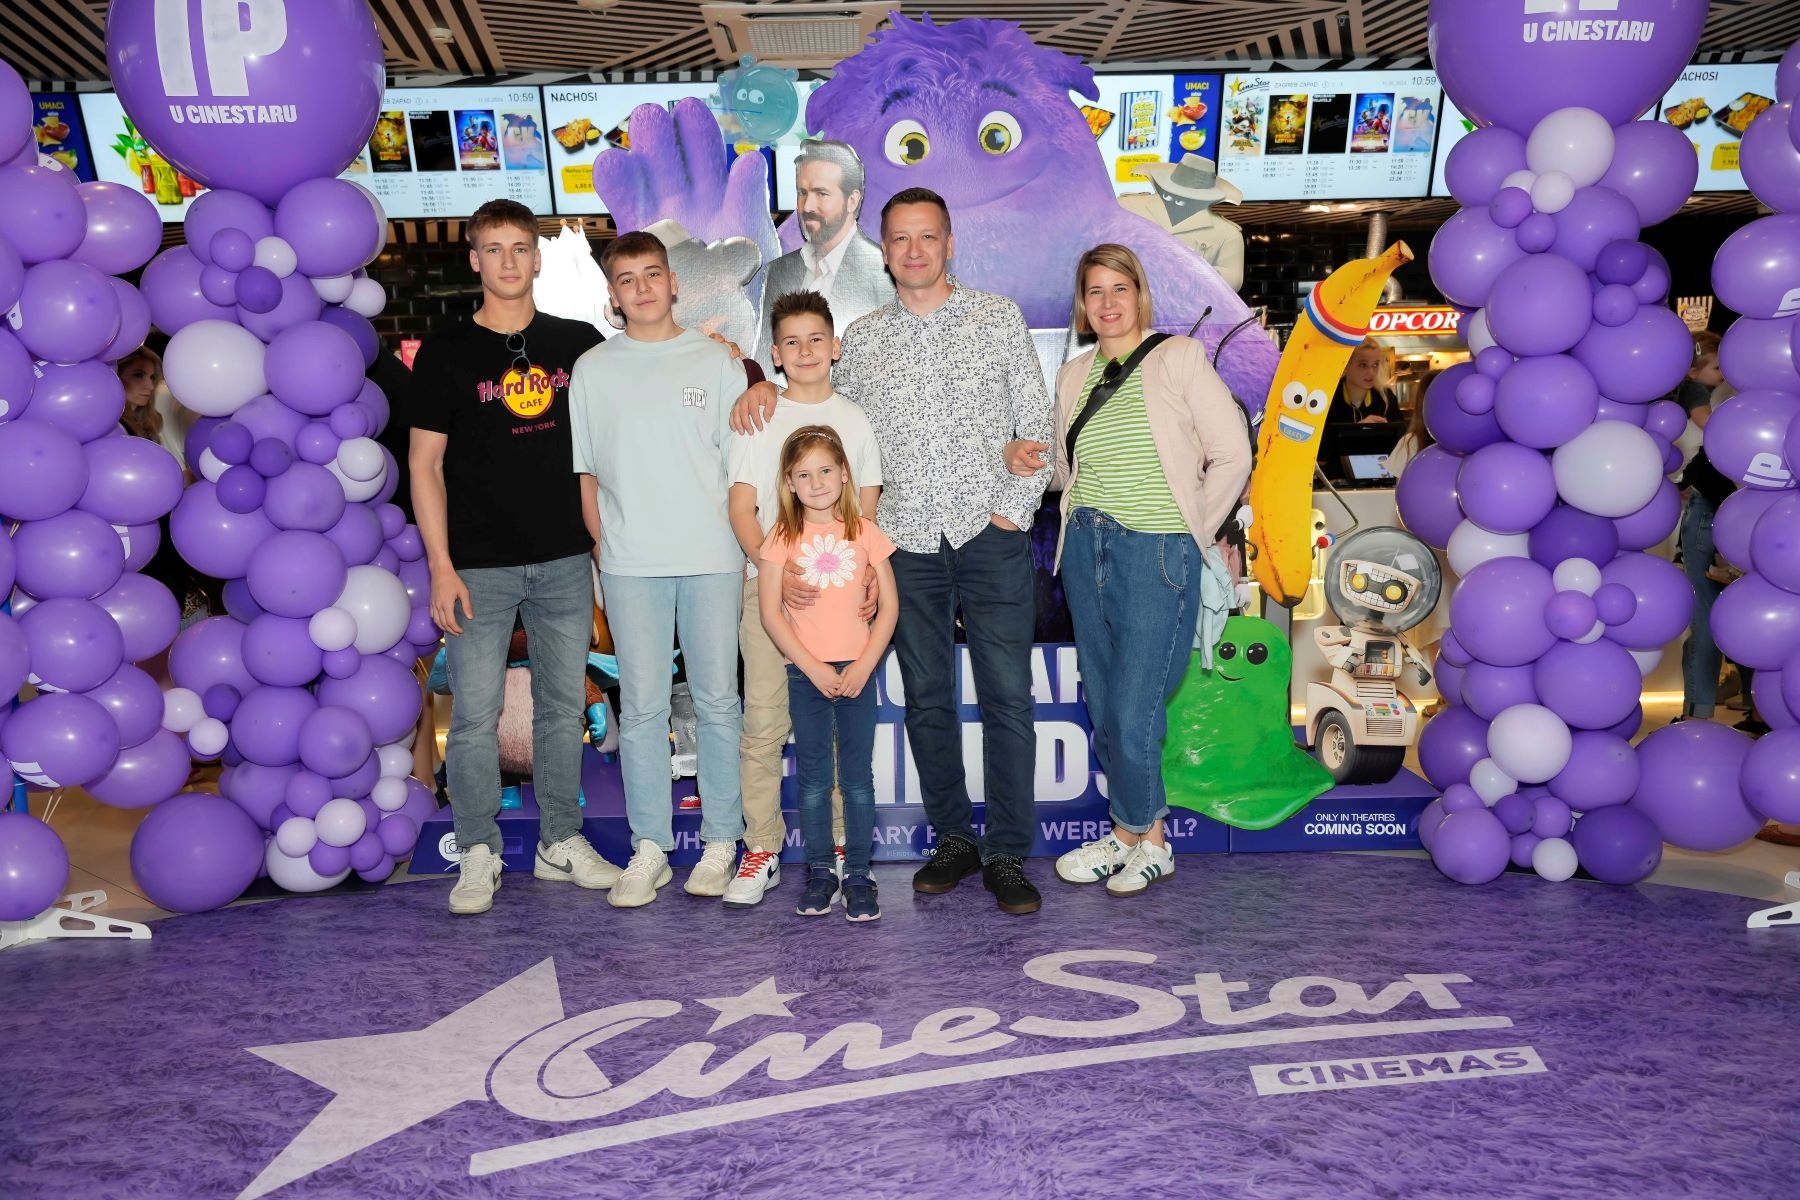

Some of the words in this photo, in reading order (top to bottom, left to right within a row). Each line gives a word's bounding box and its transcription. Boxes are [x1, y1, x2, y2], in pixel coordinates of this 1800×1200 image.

[1523, 22, 1538, 43] U
[1541, 19, 1655, 42] CINESTARU
[1412, 76, 1437, 86] 10:59
[1678, 71, 1719, 81] ACHOSI
[1185, 82, 1210, 90] UMACI
[508, 92, 534, 103] 10:59
[551, 92, 598, 102] NACHOSI
[39, 101, 64, 110] UMACI
[169, 105, 185, 124] U
[186, 104, 297, 124] CINESTARU
[1369, 312, 1464, 331] OPCOR
[477, 374, 526, 403] Hard
[529, 367, 570, 394] Rock
[519, 398, 543, 410] CAFE
[511, 425, 533, 435] NEW
[534, 420, 557, 431] YORK
[1315, 813, 1339, 822] ONLY
[1340, 813, 1350, 822] IN
[1351, 813, 1396, 822] THEATRES
[1040, 820, 1111, 841] WERE
[1304, 823, 1362, 835] COMING
[1365, 823, 1406, 835] SOON
[490, 949, 1473, 1122] CineStar
[1277, 1050, 1529, 1087] CINEMAS
